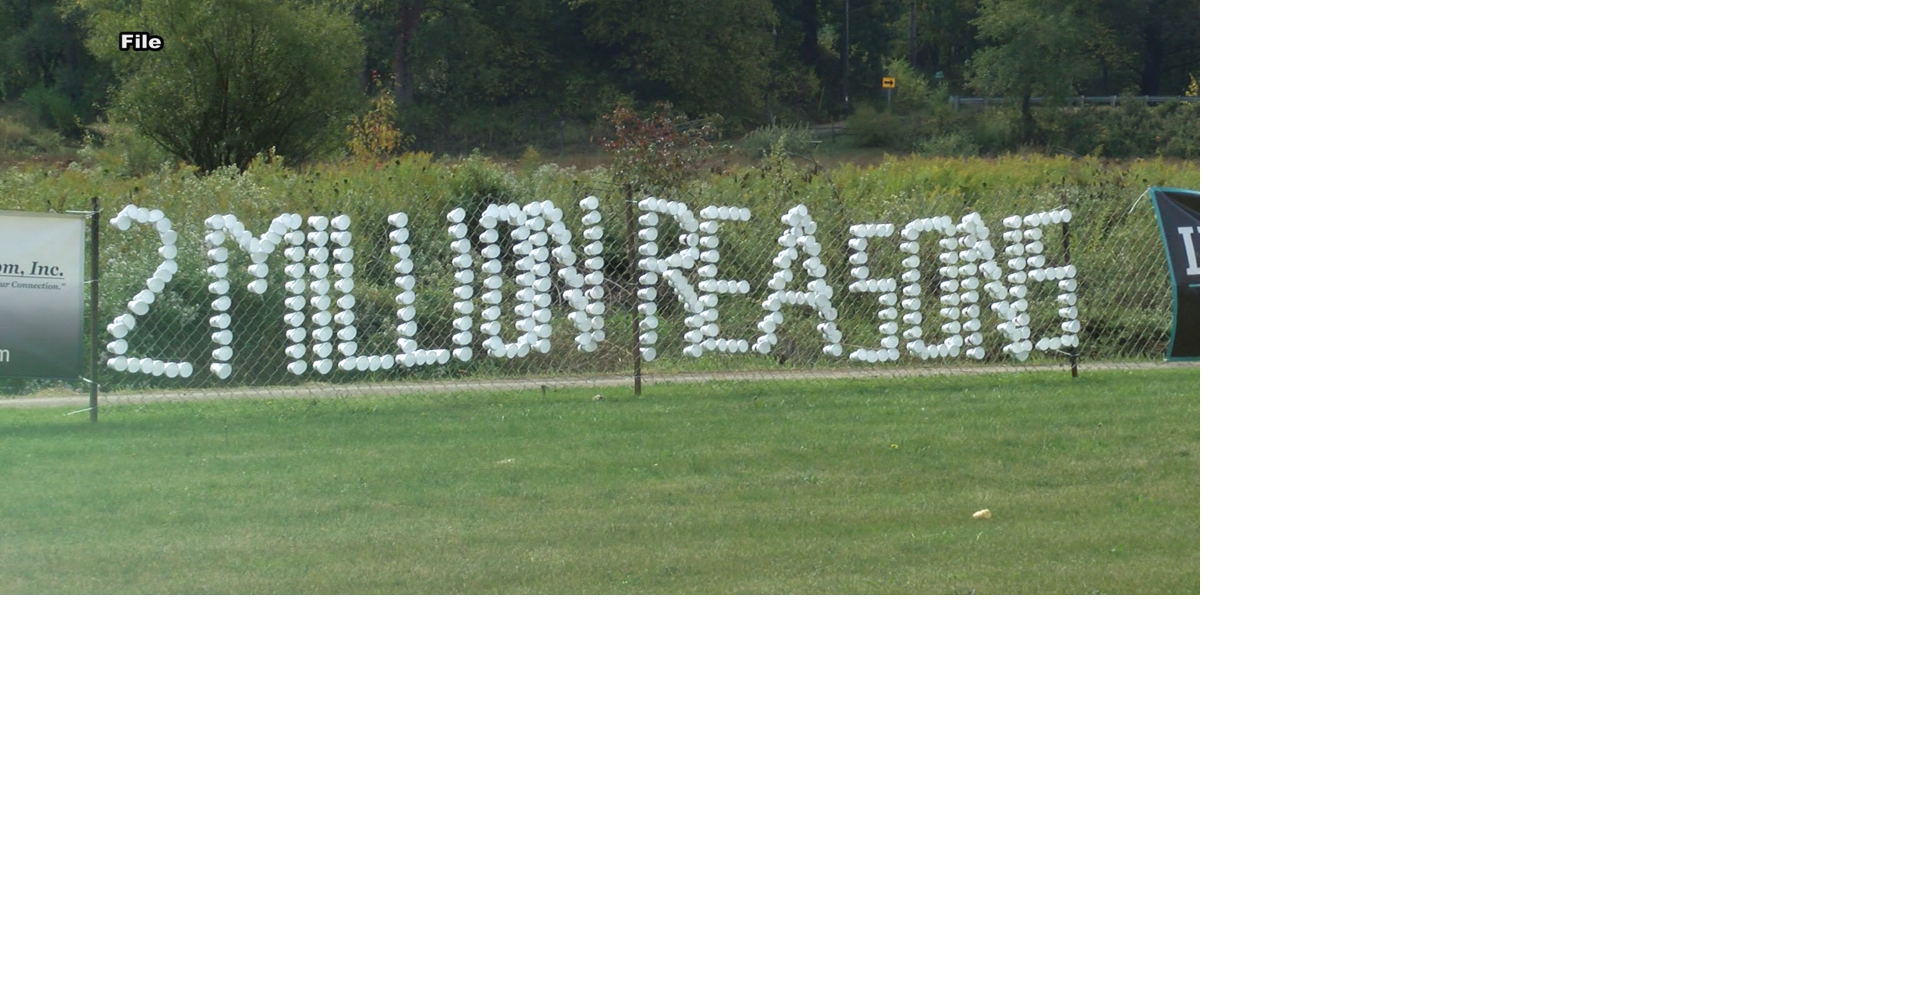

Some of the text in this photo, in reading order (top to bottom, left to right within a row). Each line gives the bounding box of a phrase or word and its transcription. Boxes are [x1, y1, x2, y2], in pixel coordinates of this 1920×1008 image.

[29, 261, 65, 277] Inc.
[107, 195, 1081, 380] 2 MILLION REASONS
